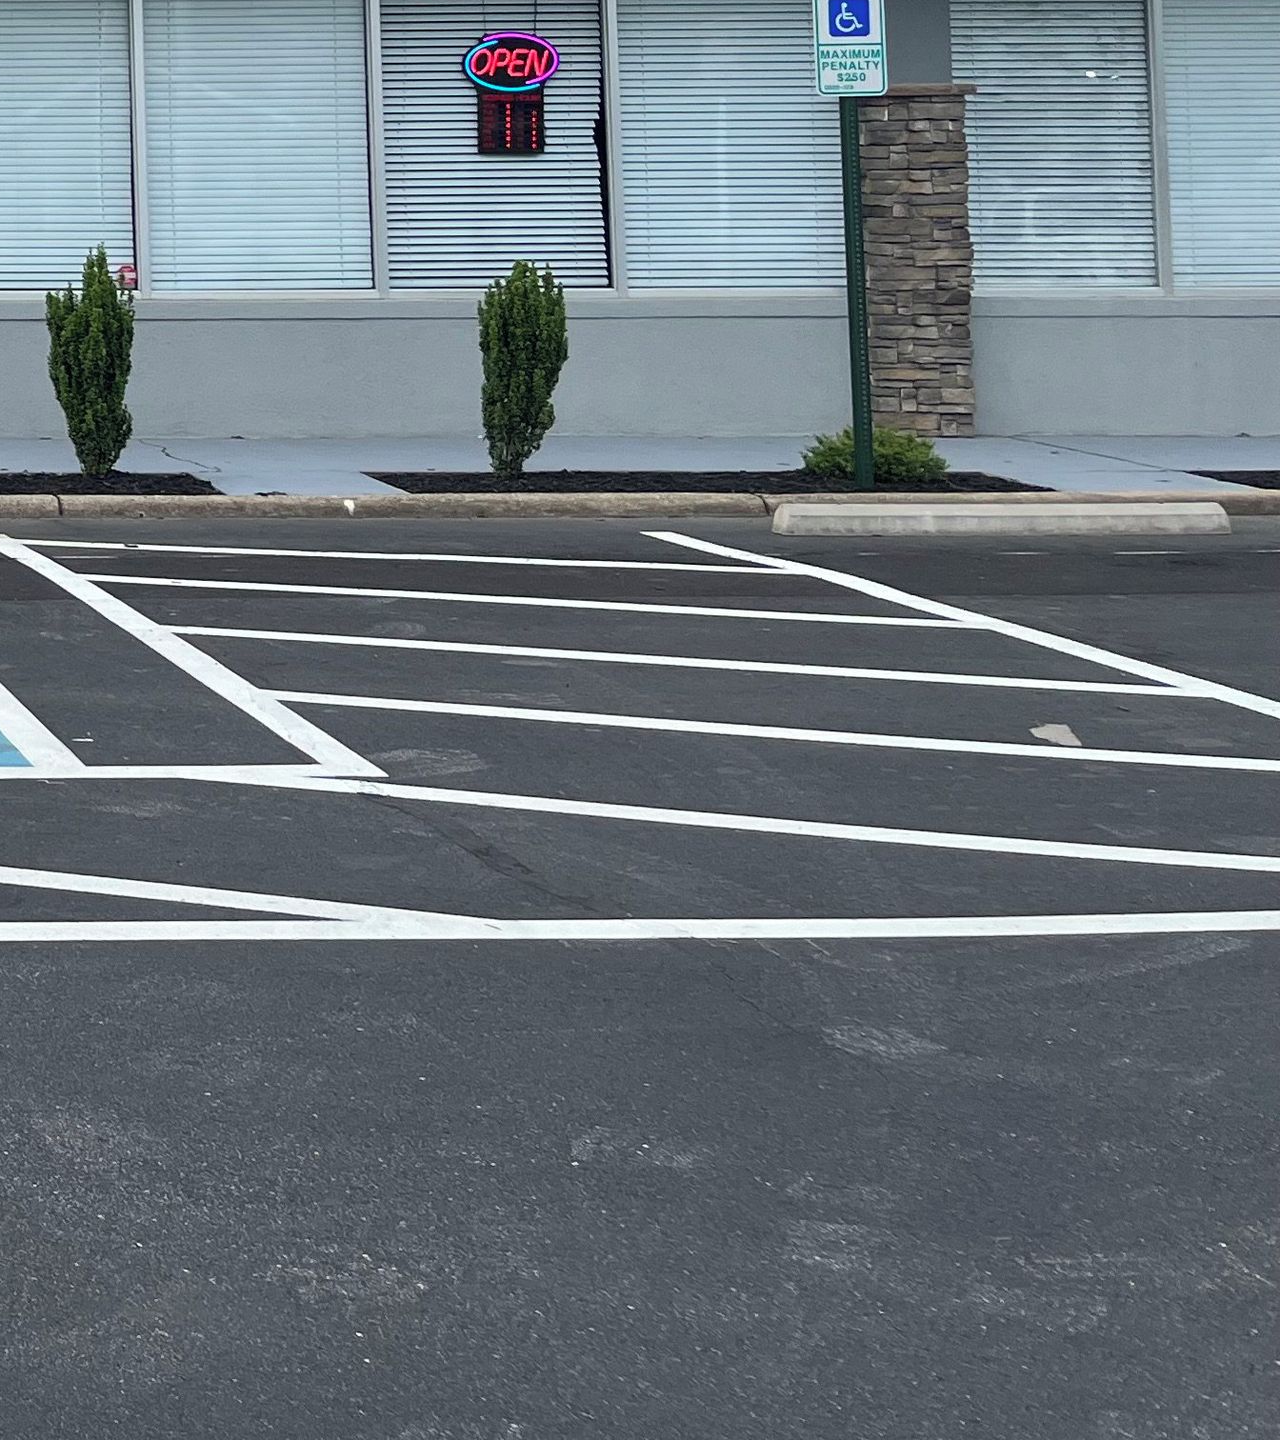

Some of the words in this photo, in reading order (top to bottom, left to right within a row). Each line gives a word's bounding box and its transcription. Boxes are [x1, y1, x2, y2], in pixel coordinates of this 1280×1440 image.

[820, 49, 881, 59] MAXIMUM
[470, 47, 549, 76] OPEN
[822, 60, 880, 71] PENALTY
[837, 73, 866, 82] $250
